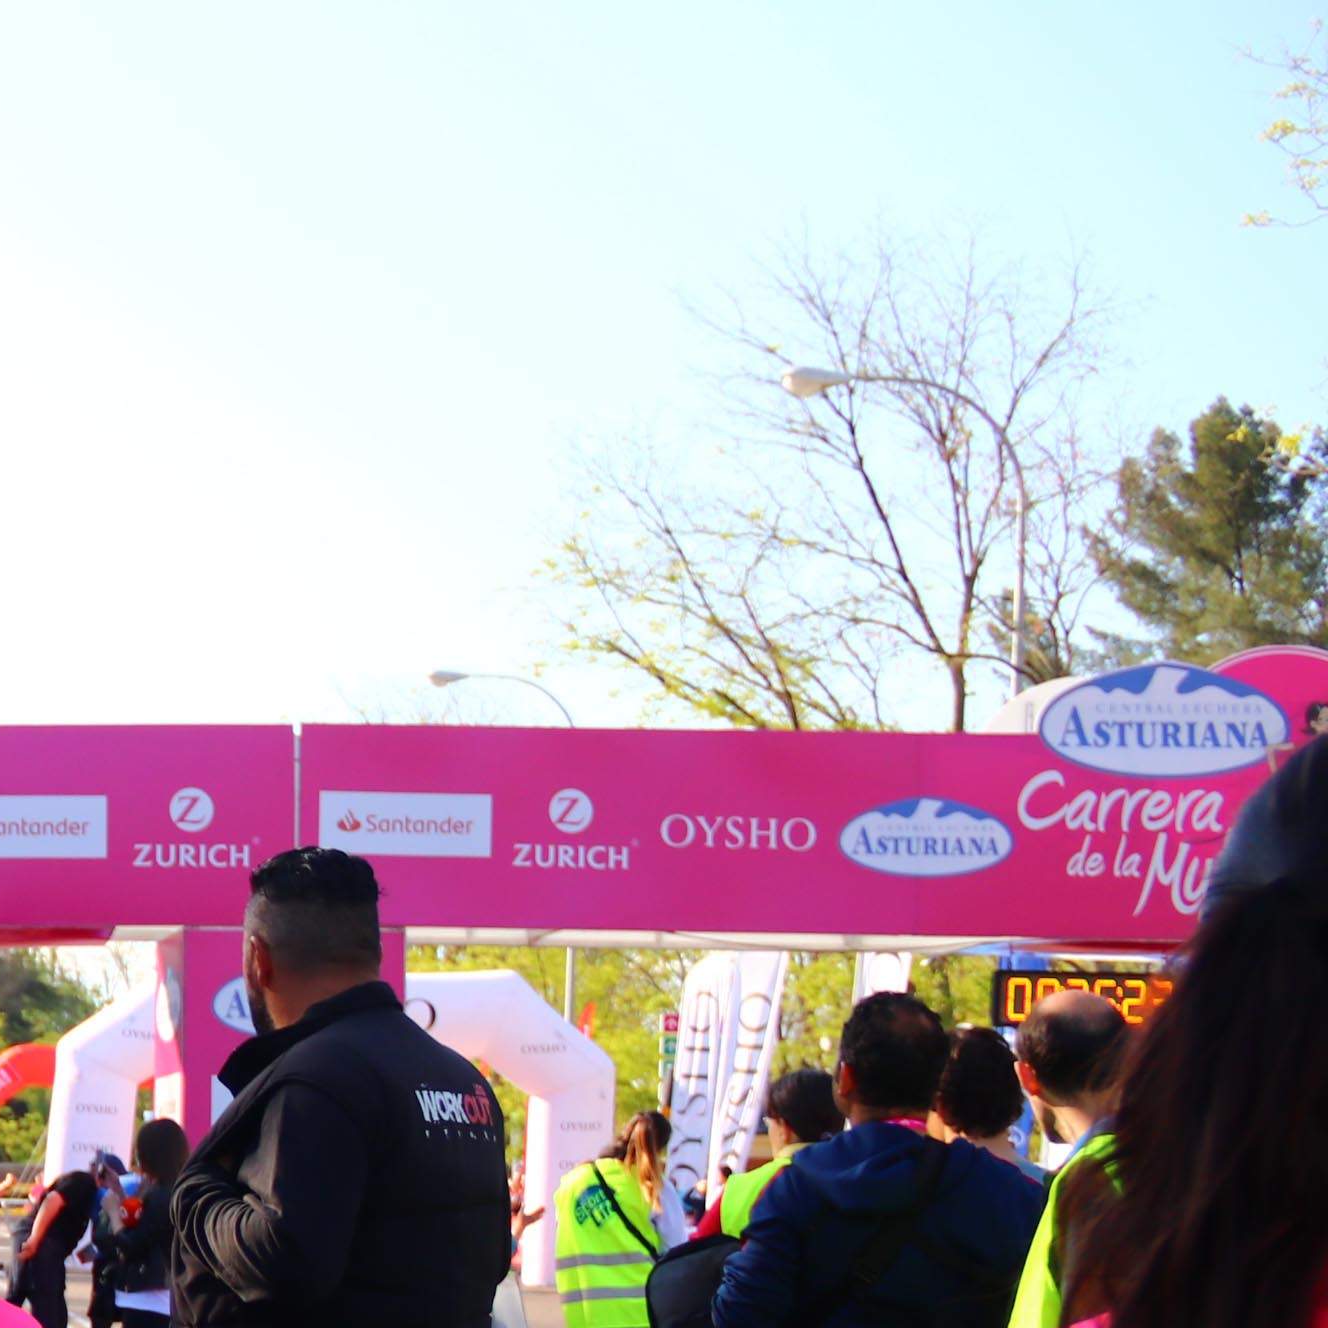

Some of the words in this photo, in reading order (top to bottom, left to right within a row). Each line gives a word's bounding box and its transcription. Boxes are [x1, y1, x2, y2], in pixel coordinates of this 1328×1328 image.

[1058, 706, 1268, 748] ASTURIANA
[1018, 769, 1224, 833] Carrera
[366, 814, 474, 836] Santander
[660, 813, 817, 851] OYSHO
[853, 826, 1000, 857] ASTURIANA
[132, 843, 250, 868] ZURICH
[512, 843, 630, 870] ZURICH
[1066, 834, 1106, 877] de
[1113, 834, 1142, 877] la
[415, 1084, 494, 1127] WORKOUT
